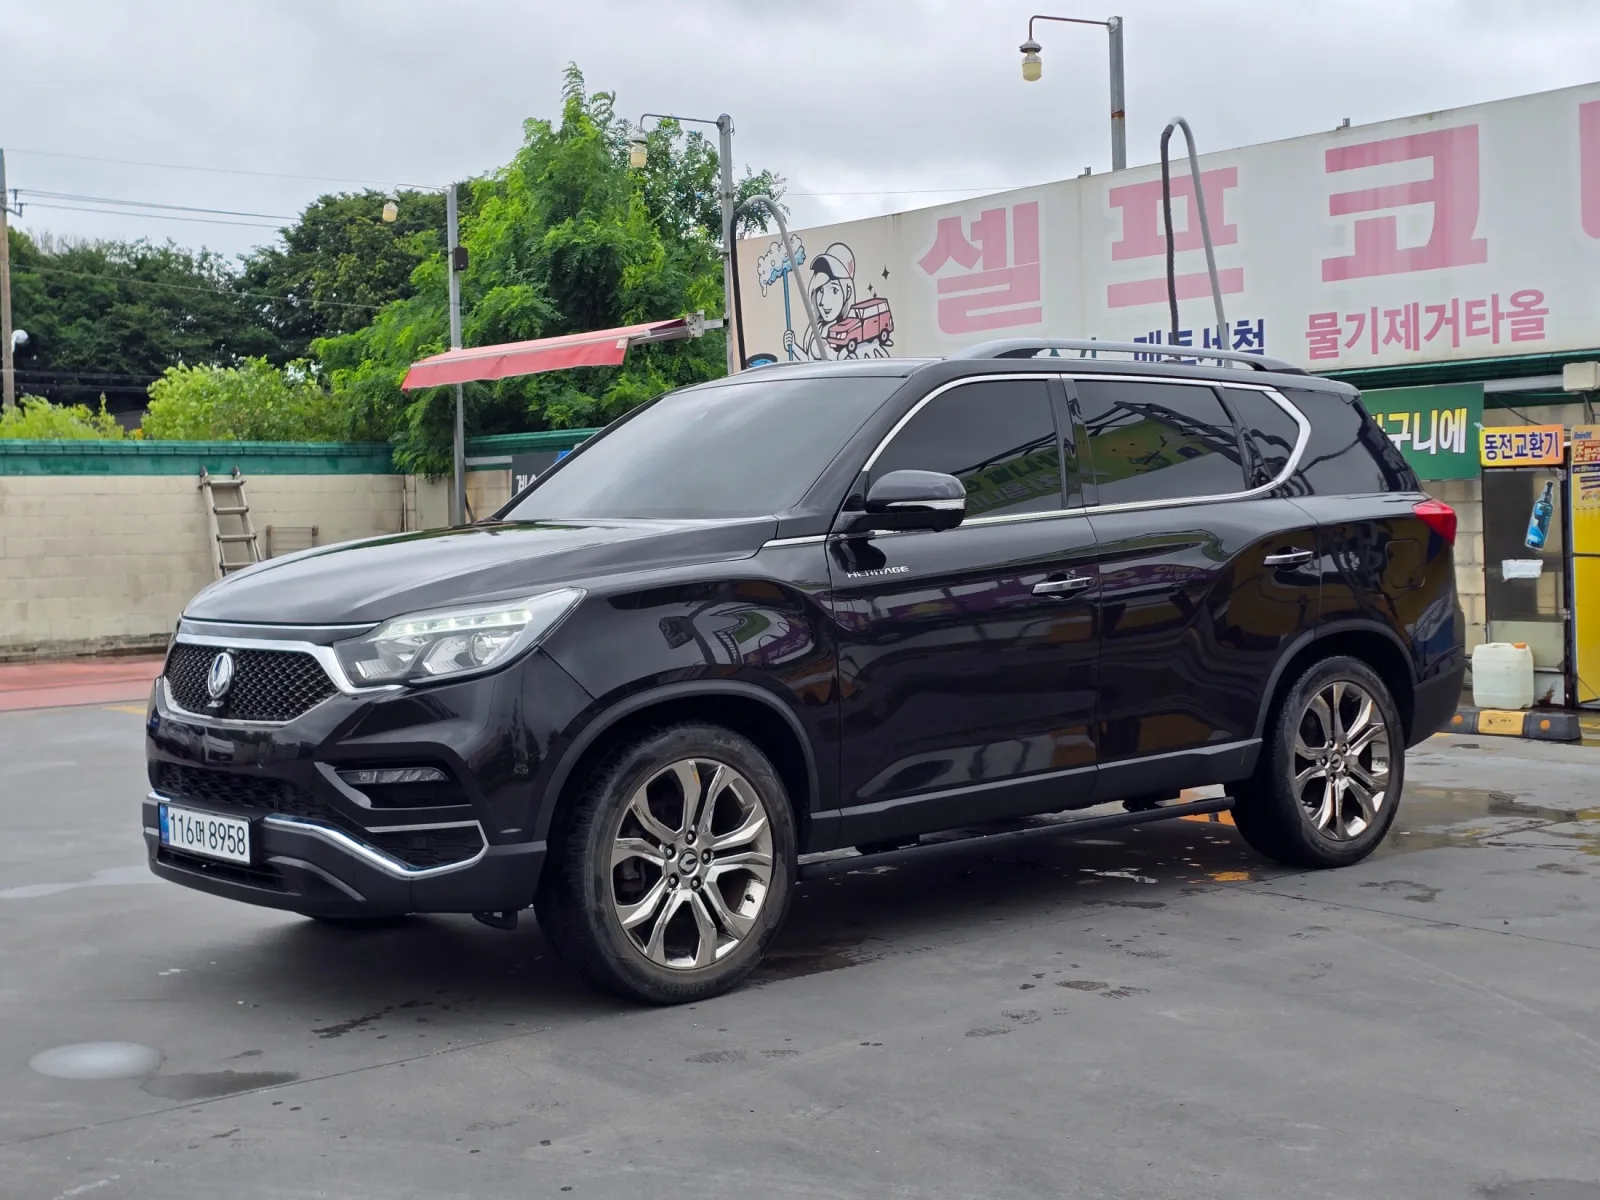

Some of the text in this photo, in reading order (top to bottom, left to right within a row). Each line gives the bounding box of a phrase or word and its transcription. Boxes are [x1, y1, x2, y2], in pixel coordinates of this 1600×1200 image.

[1305, 289, 1550, 360] 물기제거타올
[1485, 431, 1559, 461] 동전교환기
[846, 565, 910, 579] HERITAGE
[208, 820, 246, 856] 8958
